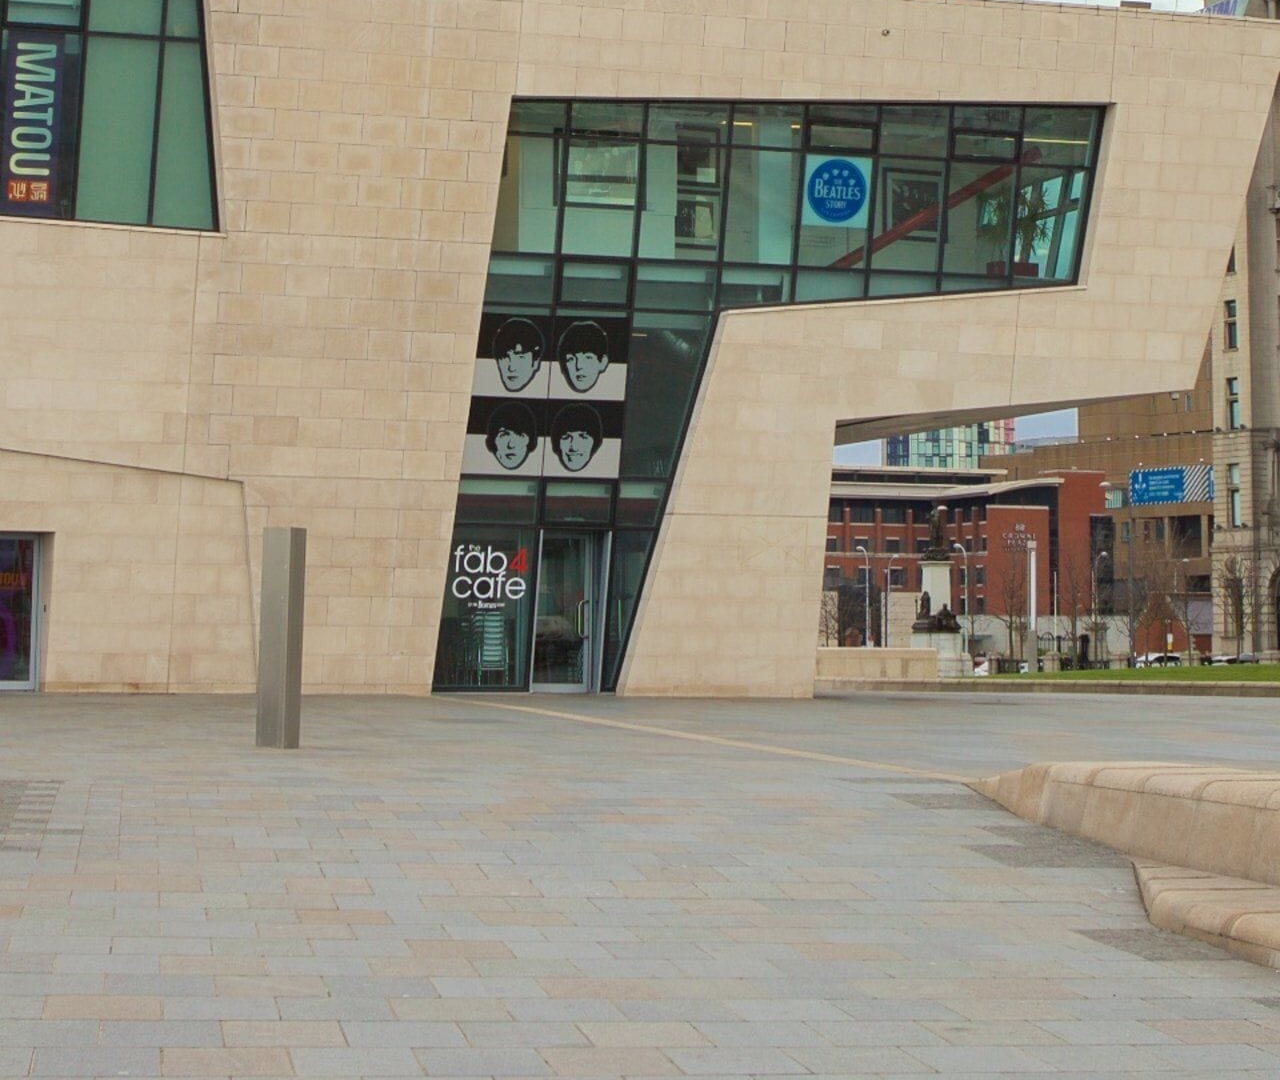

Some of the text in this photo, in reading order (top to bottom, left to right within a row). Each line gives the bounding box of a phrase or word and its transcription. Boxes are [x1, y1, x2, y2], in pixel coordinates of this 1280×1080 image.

[8, 41, 58, 177] MATOU
[814, 178, 861, 200] BEATLES
[825, 200, 848, 209] STORY
[452, 571, 526, 599] cafe
